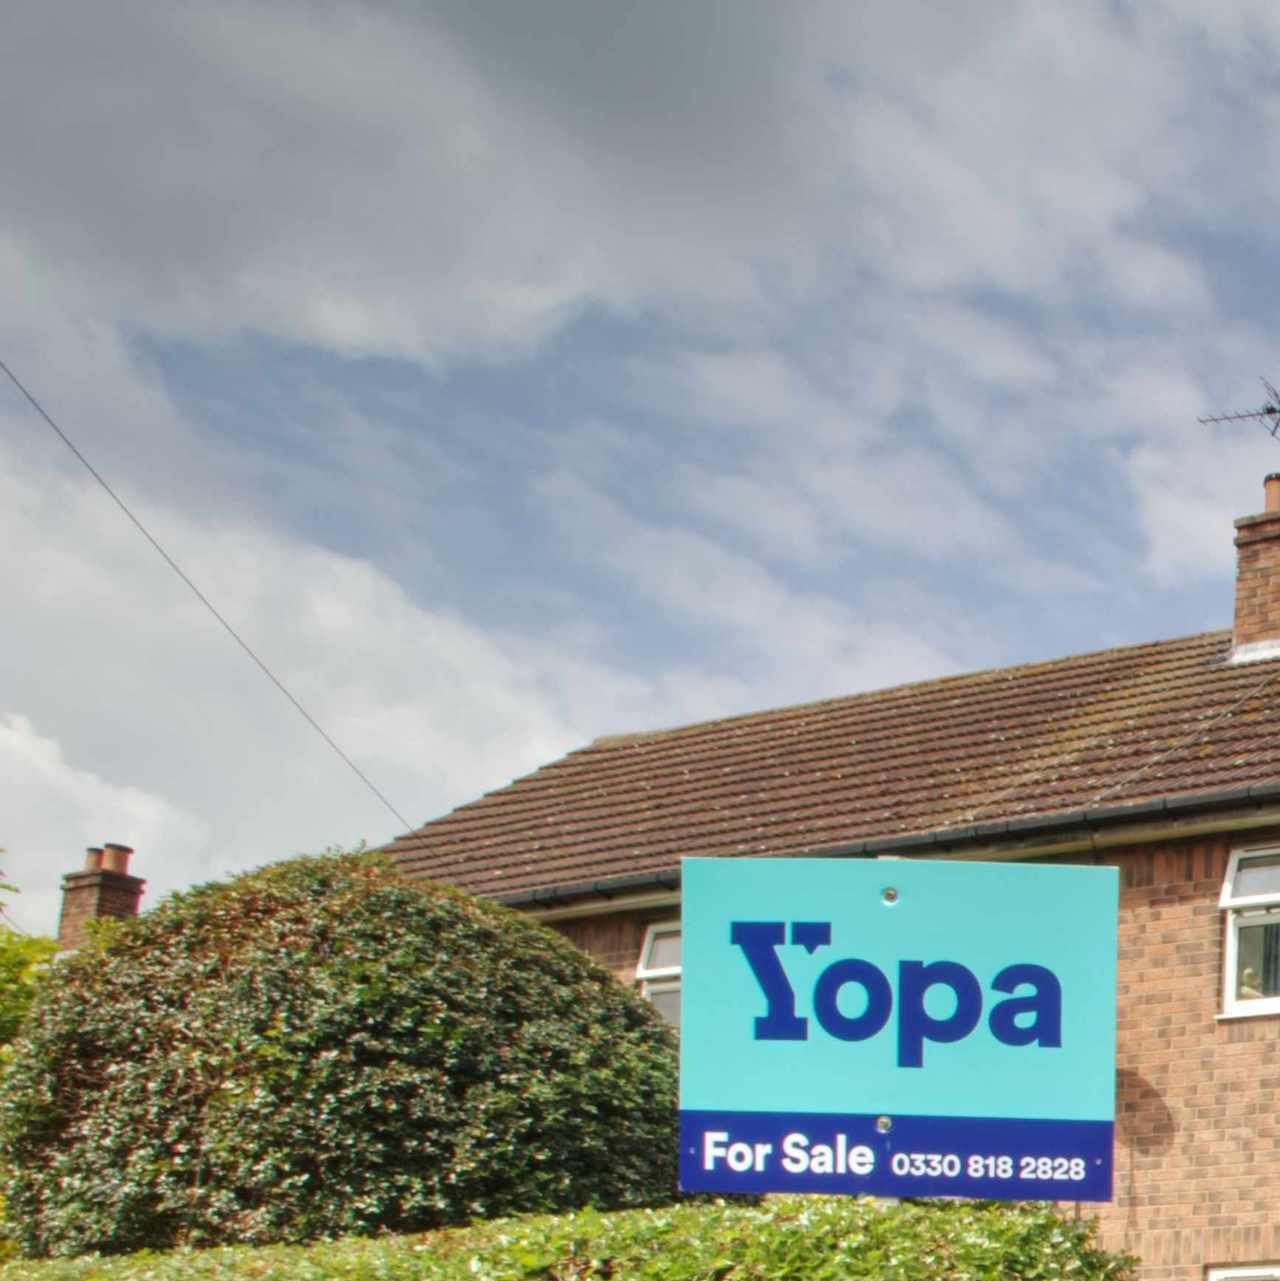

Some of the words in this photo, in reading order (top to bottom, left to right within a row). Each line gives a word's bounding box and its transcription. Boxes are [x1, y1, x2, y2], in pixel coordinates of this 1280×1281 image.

[730, 921, 1062, 1069] Yopa
[703, 1131, 773, 1172] For
[780, 1132, 875, 1176] Sale
[891, 1152, 961, 1178] 0330
[967, 1154, 1014, 1179] 818
[1018, 1156, 1086, 1181] 2828
